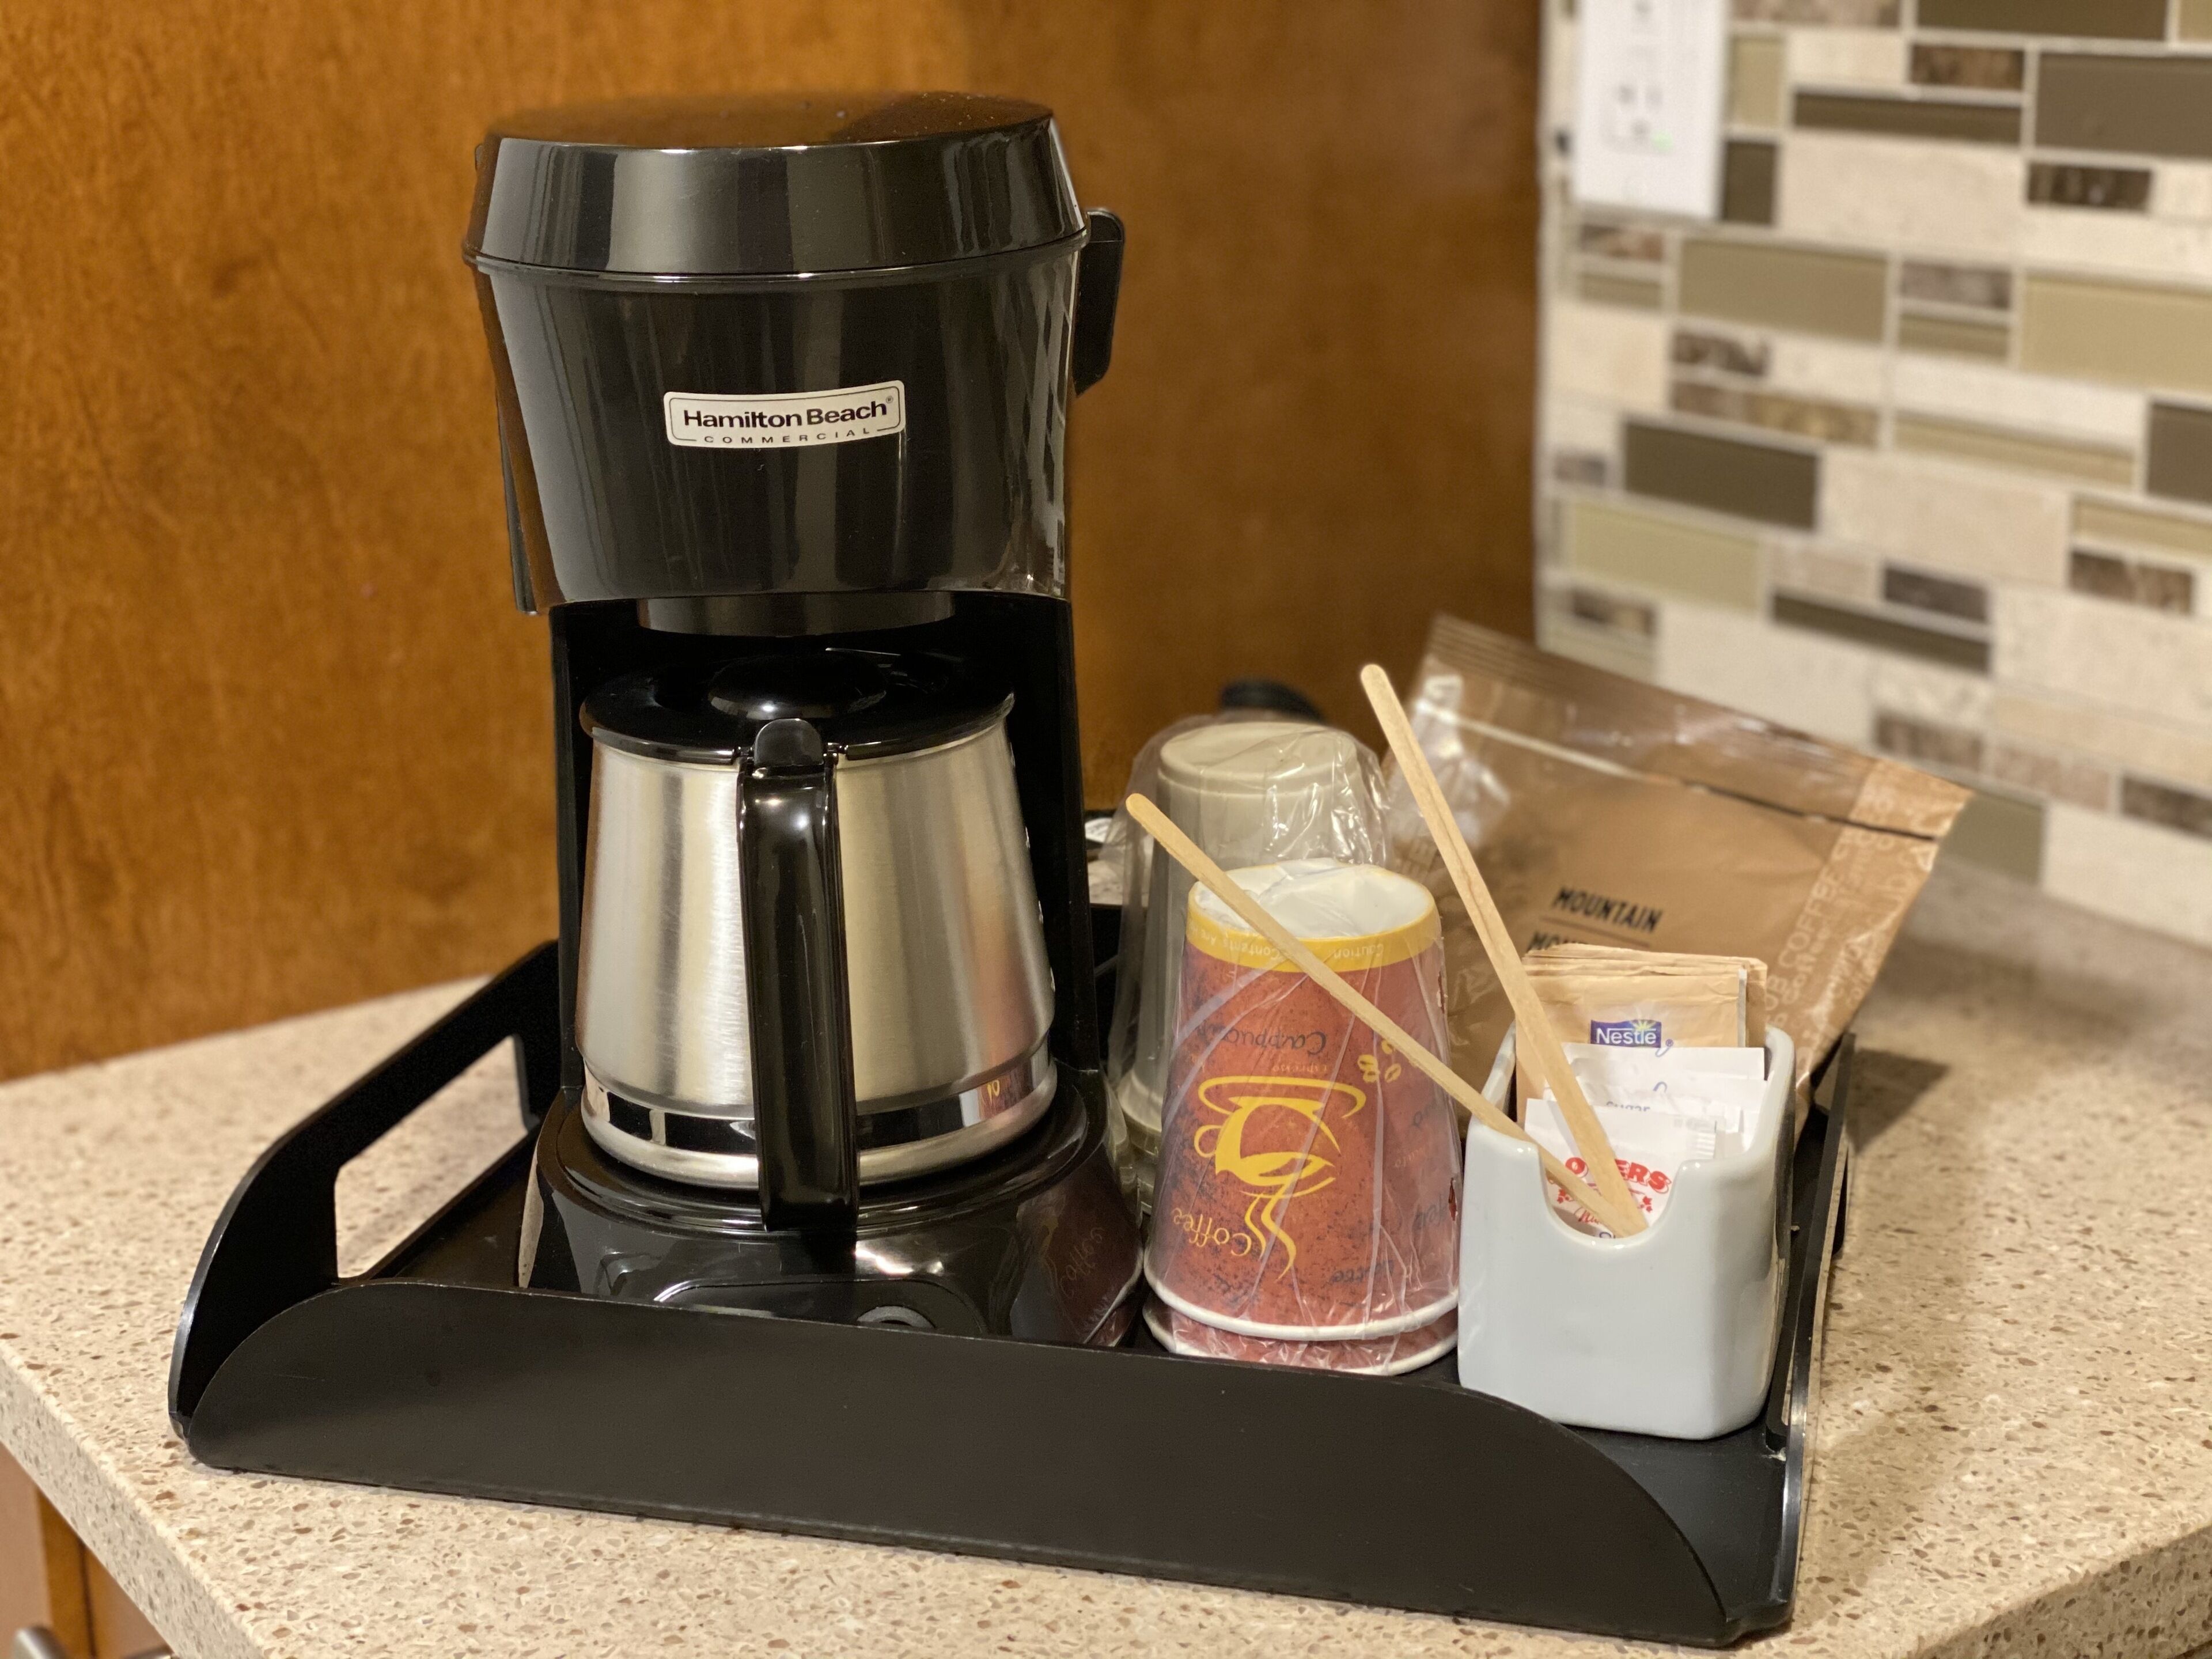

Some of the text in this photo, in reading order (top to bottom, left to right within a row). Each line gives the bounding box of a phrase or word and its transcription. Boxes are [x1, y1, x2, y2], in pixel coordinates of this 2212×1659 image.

[684, 410, 802, 428] Hamilton
[704, 427, 870, 444] COMMERCIAL
[1552, 887, 1663, 933] MOUNTAIN
[1334, 943, 1384, 959] Caution
[1171, 1207, 1252, 1256] Coffee
